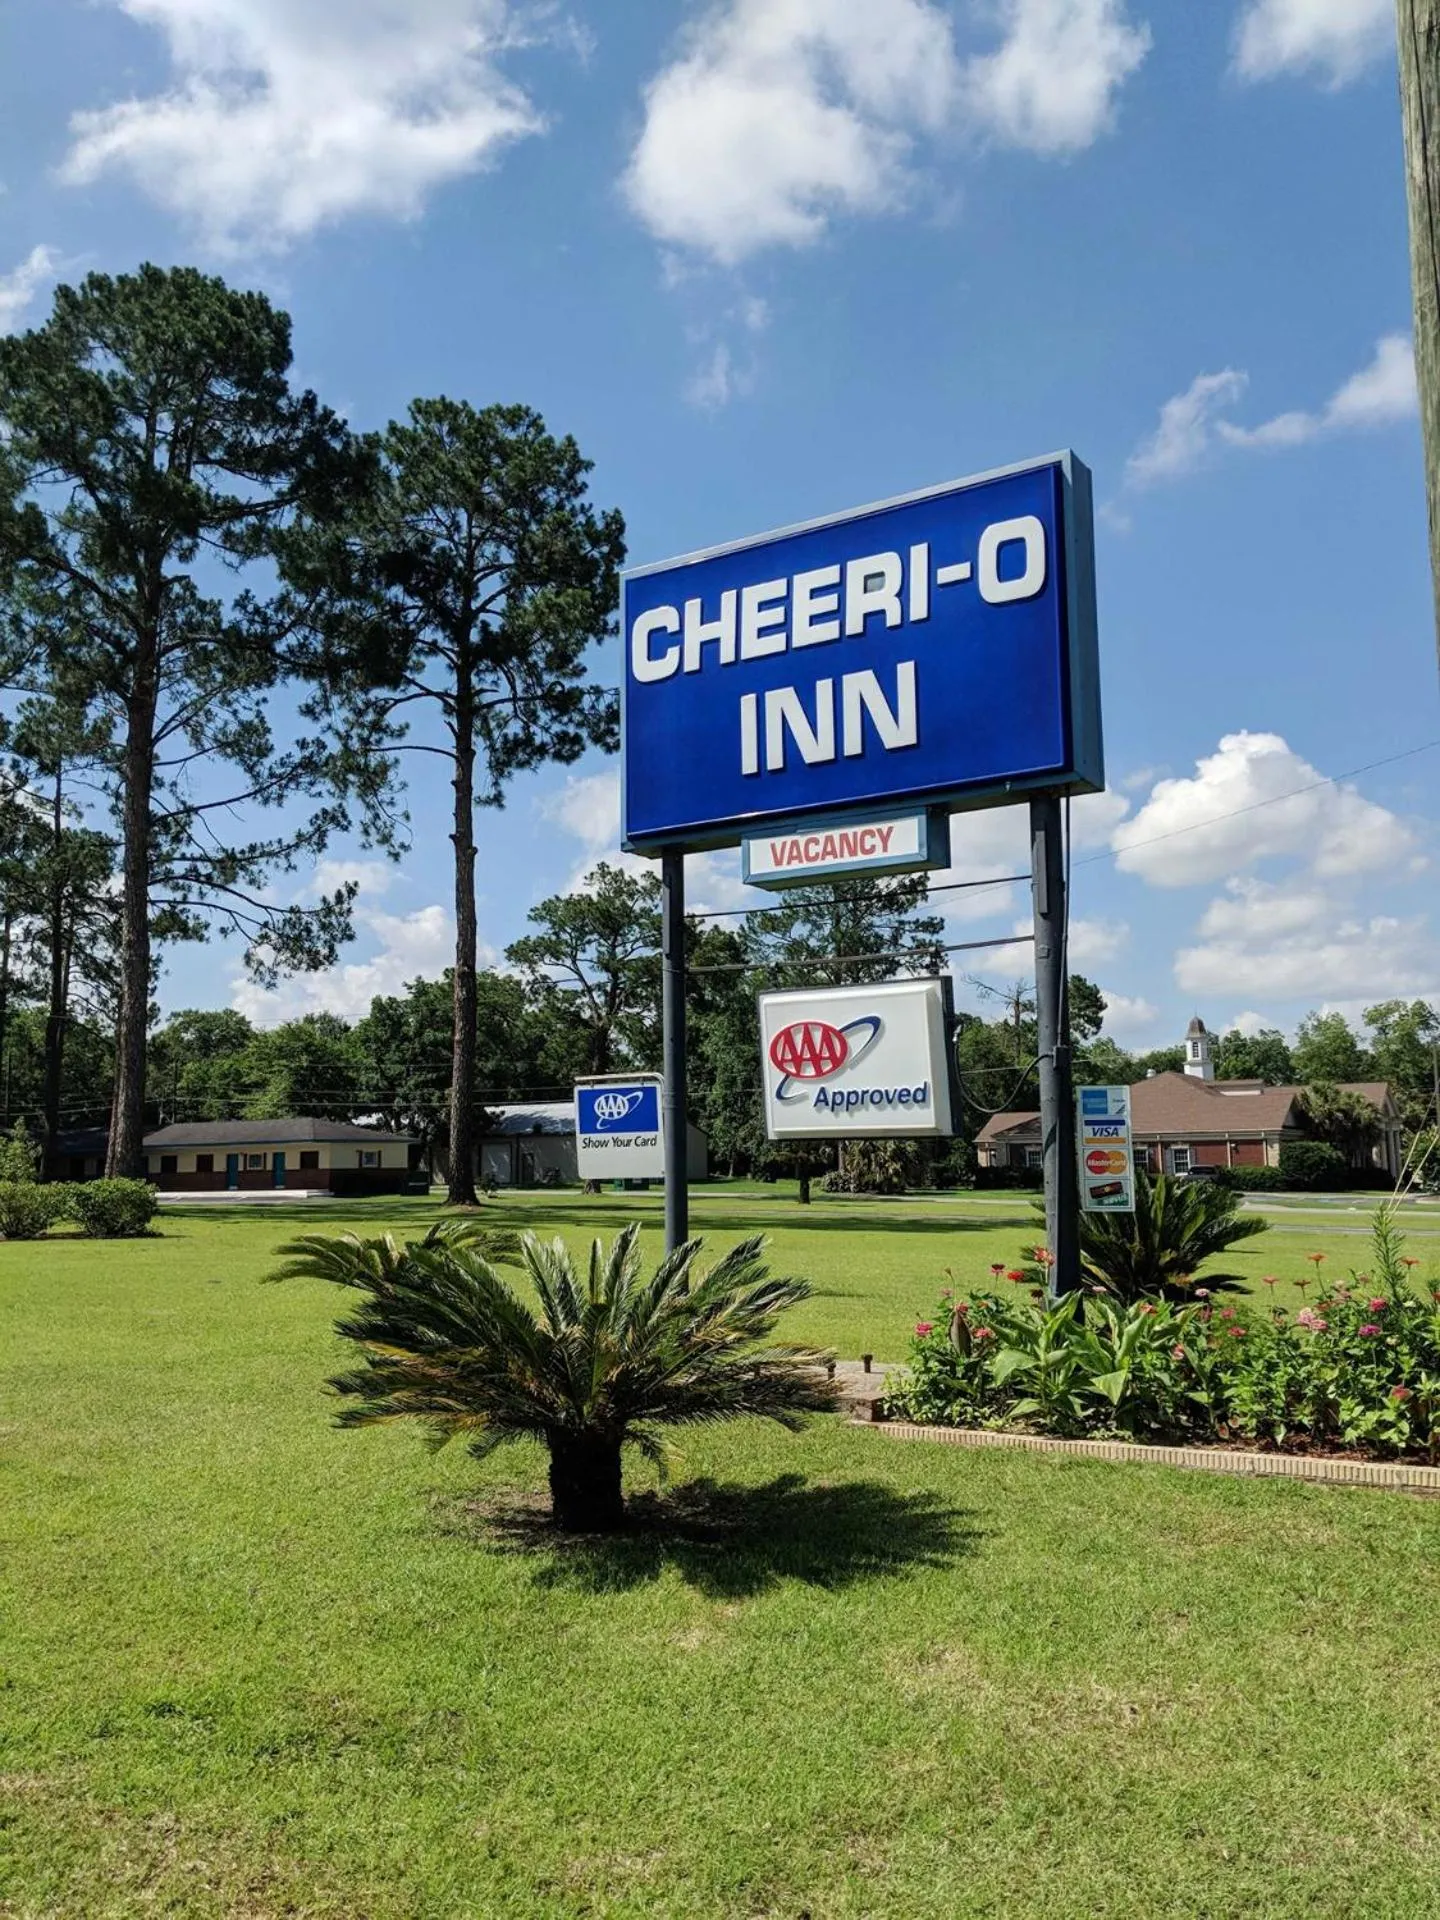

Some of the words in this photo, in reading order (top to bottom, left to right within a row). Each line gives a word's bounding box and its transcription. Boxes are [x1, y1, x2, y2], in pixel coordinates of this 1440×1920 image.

[632, 515, 1046, 683] CHEERI-O
[740, 660, 918, 776] INN
[770, 826, 894, 867] VACANCY
[771, 1023, 847, 1078] AAA
[595, 1094, 628, 1120] AAA
[814, 1082, 929, 1112] Approved
[582, 1137, 610, 1149] Show
[611, 1136, 632, 1148] Your
[634, 1135, 657, 1147] Card
[1092, 1127, 1119, 1137] VISA
